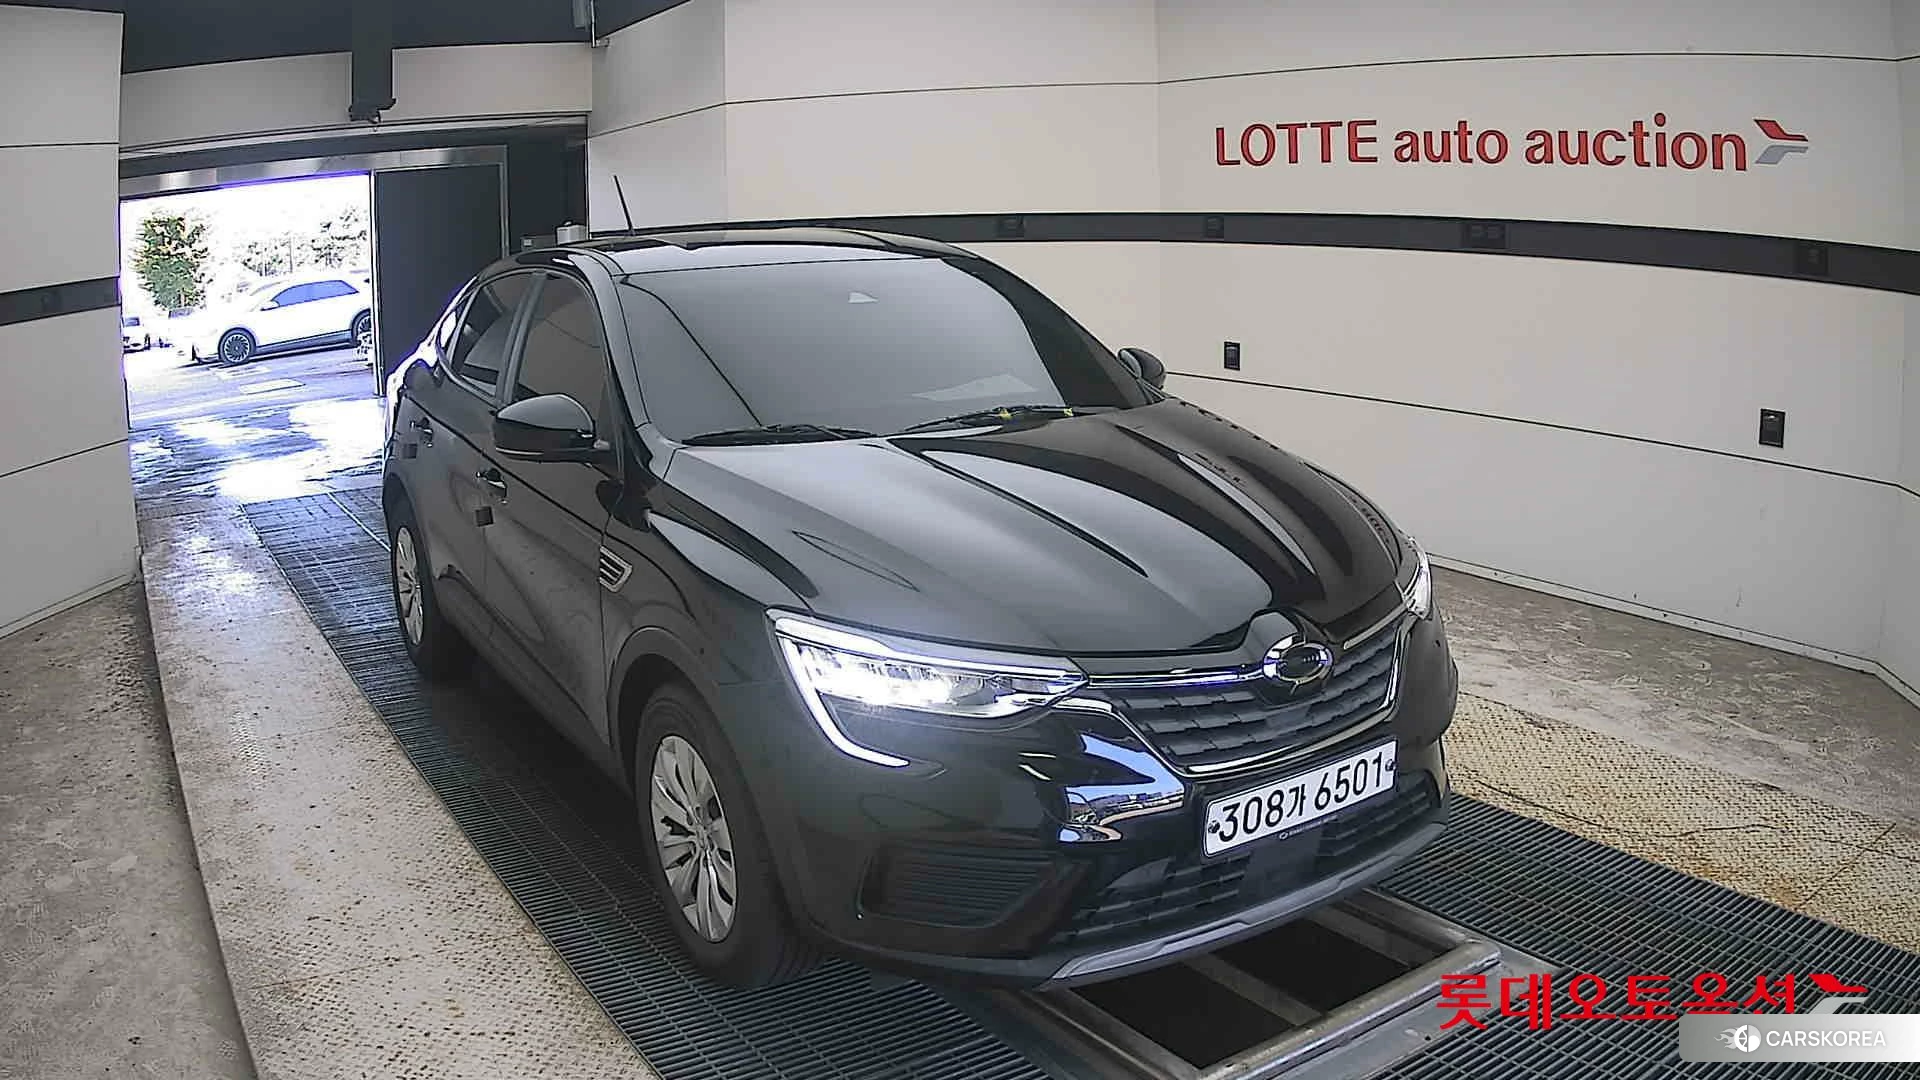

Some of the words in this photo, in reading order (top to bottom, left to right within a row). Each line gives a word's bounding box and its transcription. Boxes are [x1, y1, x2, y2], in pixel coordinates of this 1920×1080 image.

[1215, 119, 1377, 166] LOTTE
[1394, 120, 1509, 163] auto
[1525, 113, 1748, 171] auction
[1218, 783, 1306, 842] 308가
[1314, 751, 1383, 811] 6501
